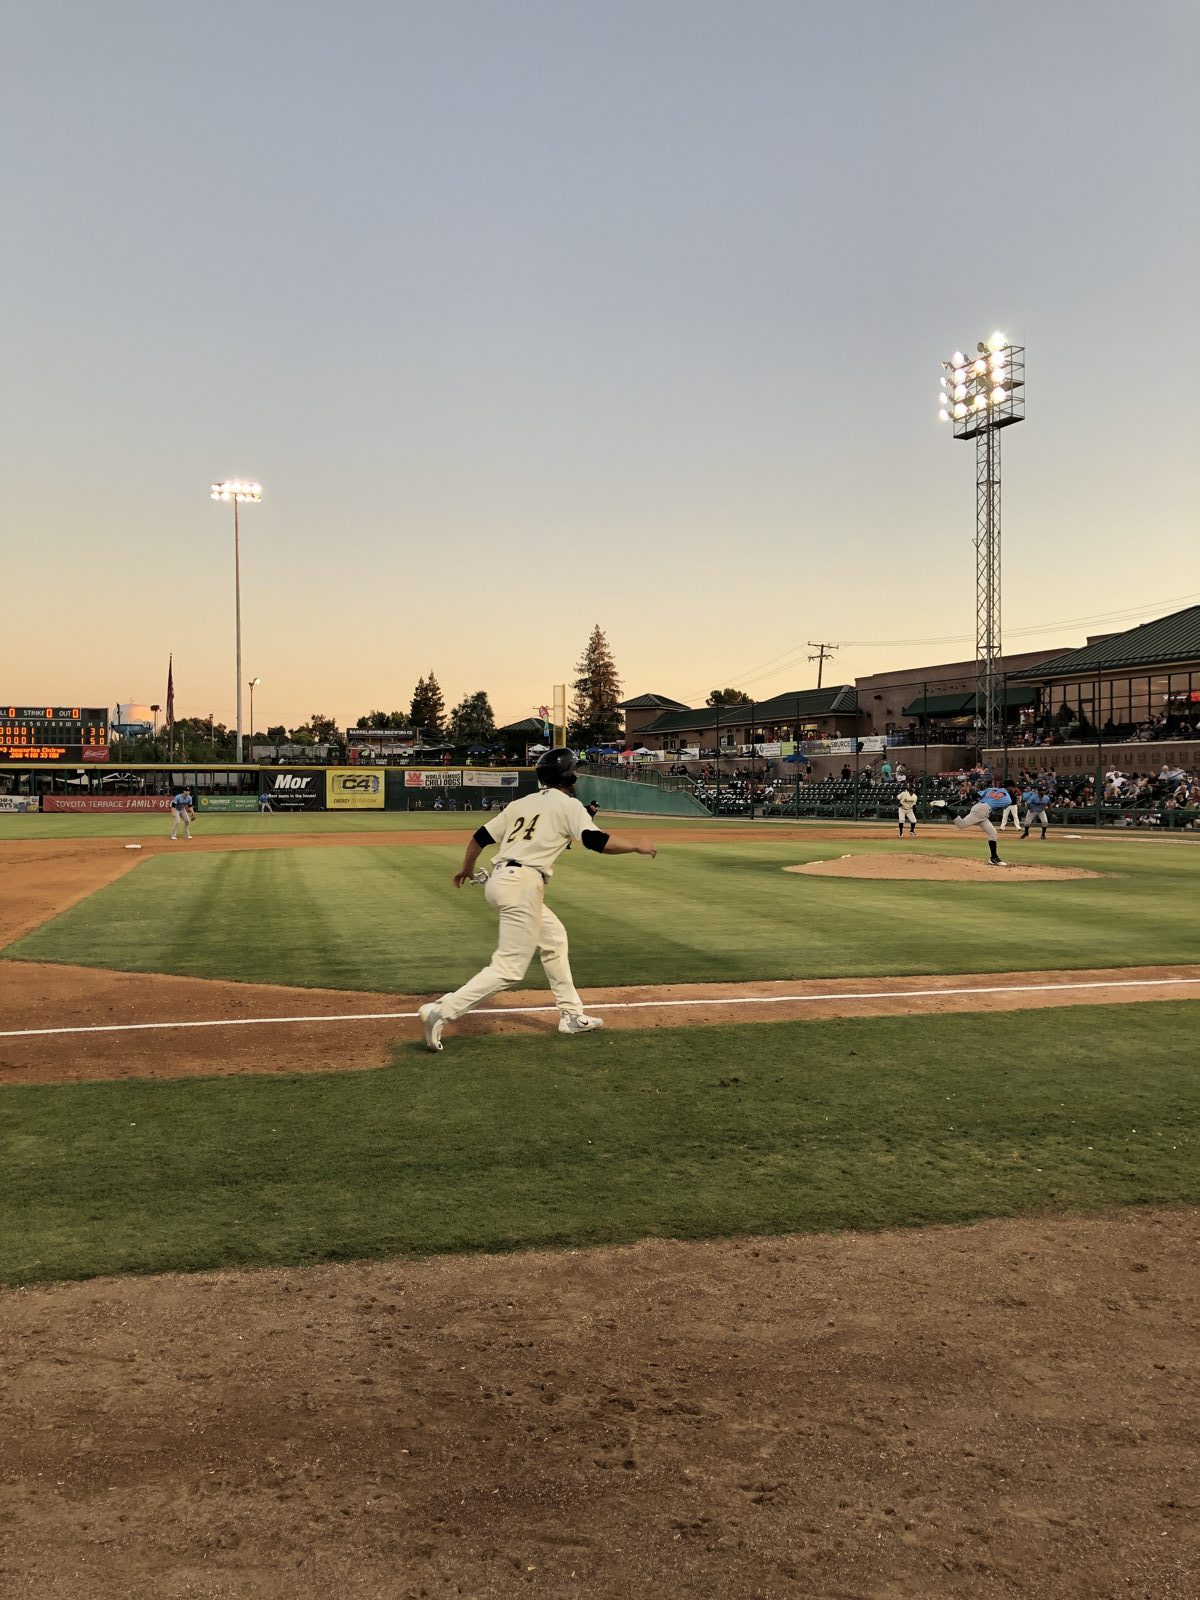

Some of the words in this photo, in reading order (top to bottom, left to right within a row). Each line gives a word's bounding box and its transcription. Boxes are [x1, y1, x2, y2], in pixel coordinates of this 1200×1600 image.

[9, 708, 16, 718] 0
[46, 708, 53, 718] 0
[72, 709, 79, 719] 0
[6, 727, 11, 735] 0
[13, 727, 19, 735] 0
[21, 727, 26, 735] 0
[90, 728, 96, 736] 3
[99, 728, 104, 736] 0
[6, 736, 11, 744] 0
[13, 736, 19, 744] 0
[21, 736, 26, 744] 0
[90, 737, 96, 745] 5
[99, 737, 104, 745] 0
[274, 774, 311, 789] Mor
[342, 778, 370, 790] C4
[443, 778, 461, 786] DOGS
[56, 800, 87, 808] TOYOTA
[88, 800, 126, 808] TERRACE
[126, 800, 157, 808] FAMILY
[506, 813, 540, 844] 24
